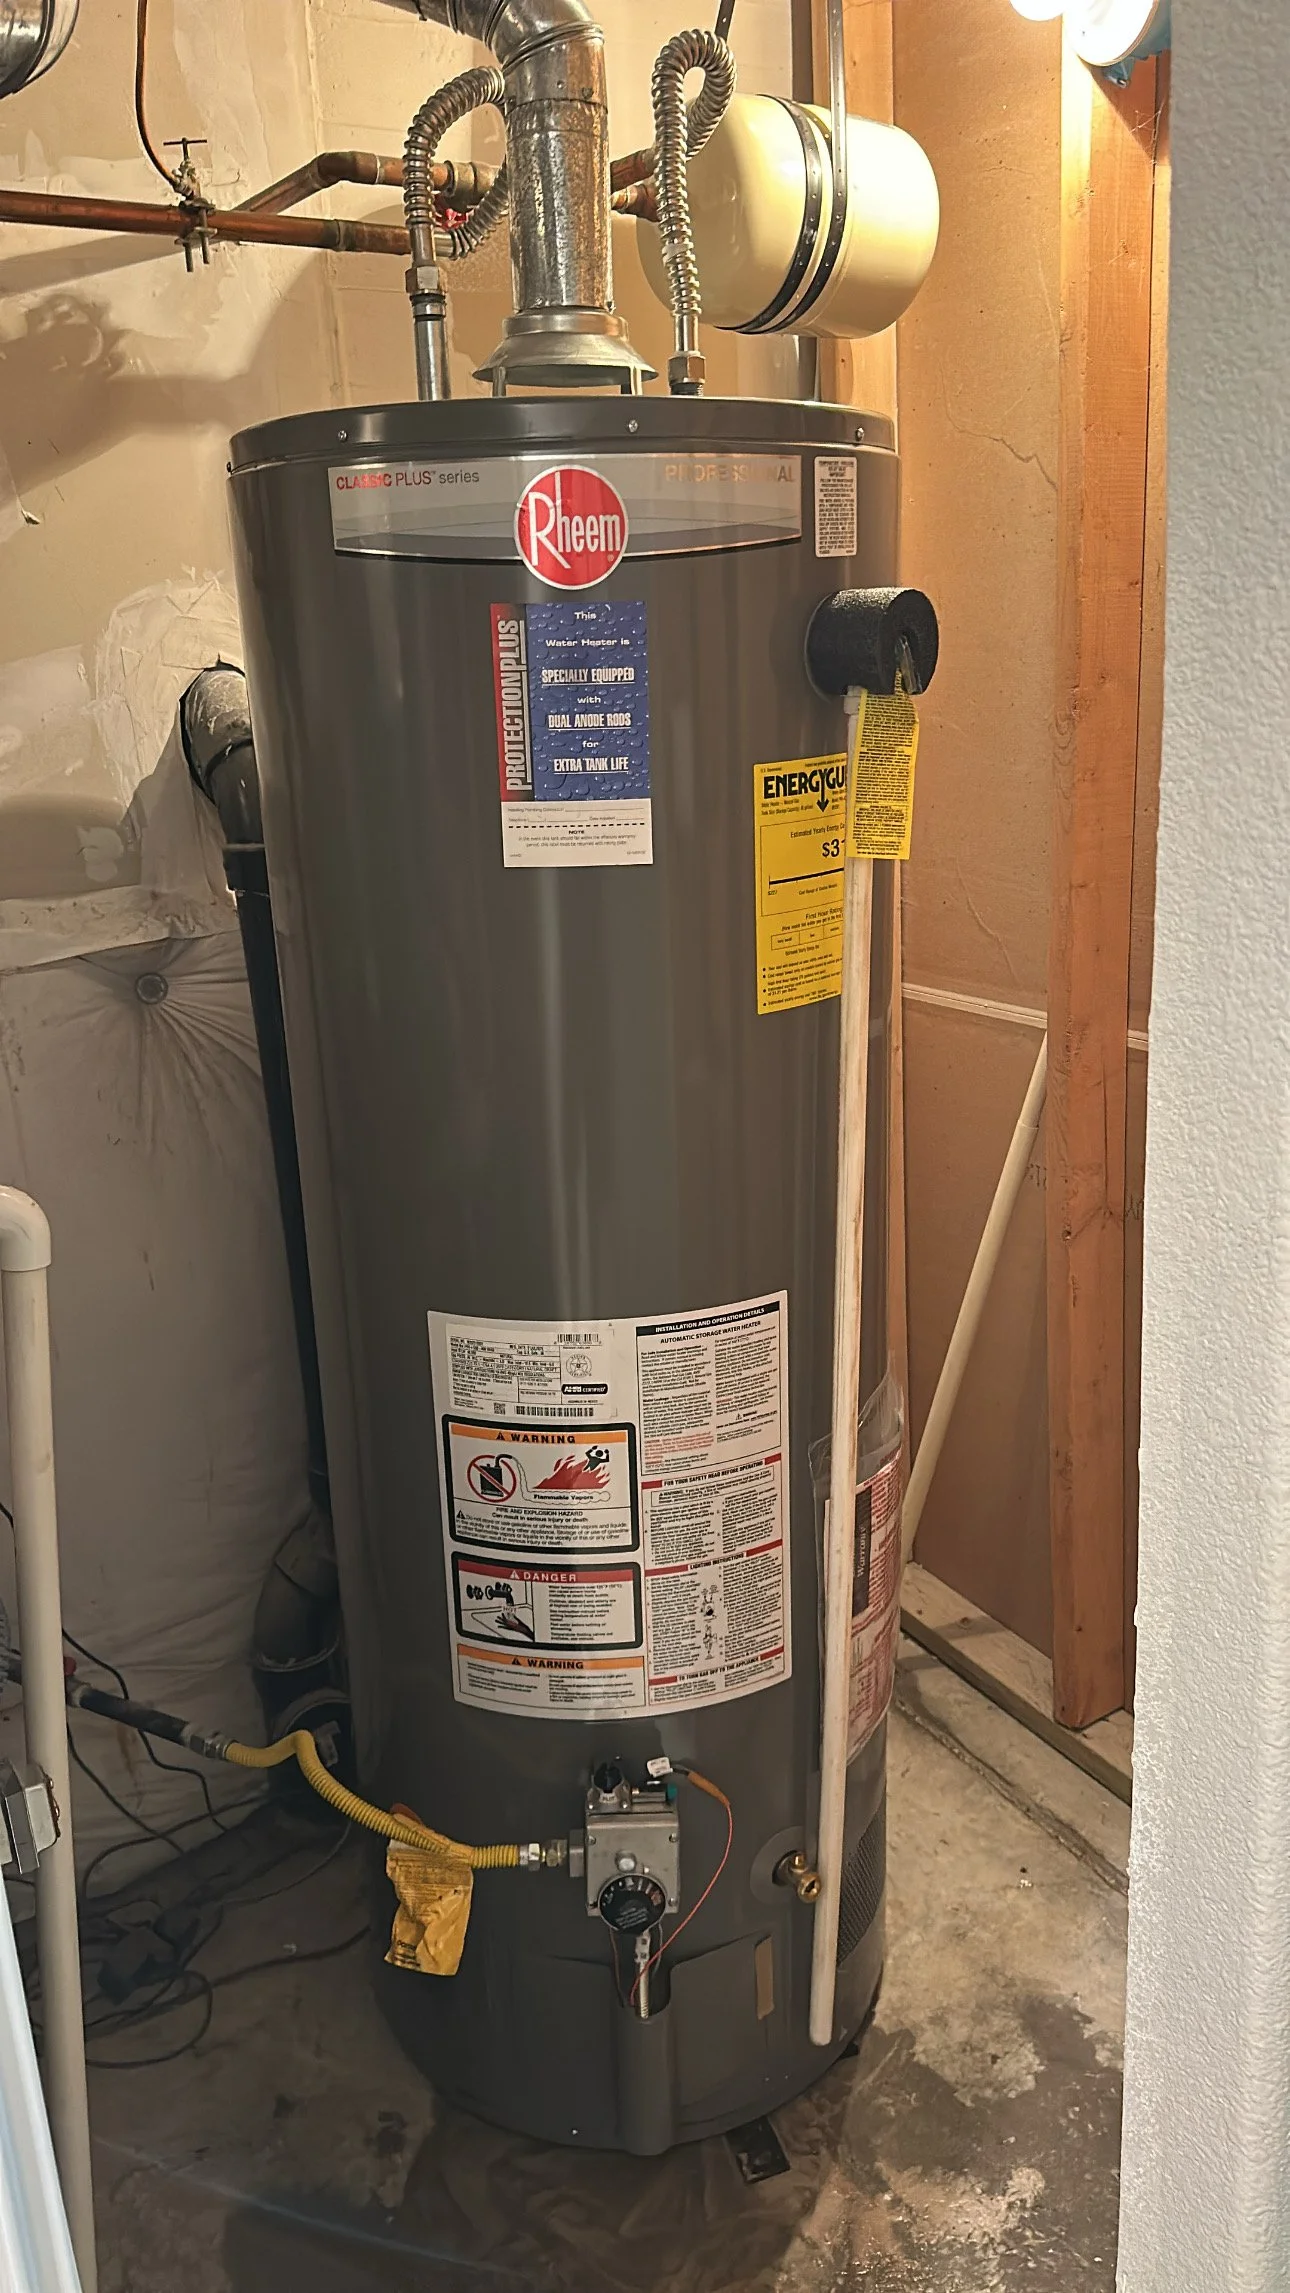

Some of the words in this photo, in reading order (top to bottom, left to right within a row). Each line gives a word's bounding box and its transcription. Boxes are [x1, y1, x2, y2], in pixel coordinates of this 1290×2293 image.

[336, 472, 392, 490] CLASSIC
[439, 470, 480, 484] series
[665, 464, 794, 482] PROFESSNAL
[528, 471, 620, 569] Rheem
[574, 611, 597, 621] This
[545, 639, 577, 647] Water
[581, 639, 617, 647] Heater
[542, 669, 588, 683] SPECIALLY
[592, 667, 634, 683] EQUIPPED
[577, 696, 601, 704] with
[548, 715, 571, 728] DUAL
[574, 714, 604, 727] ANODE
[607, 713, 631, 726] RODS
[582, 740, 599, 748] for
[554, 758, 582, 772] EXTRA
[586, 758, 608, 771] TANK
[610, 757, 629, 770] LIFE
[764, 765, 847, 800] ENERGYGU
[791, 830, 812, 838] Estimated
[827, 825, 839, 833] Energy
[655, 1323, 697, 1332] INSTALLATION
[712, 1313, 743, 1324] OPERATION
[744, 1308, 765, 1317] DETAILS
[660, 1334, 694, 1344] AUTOMATIC
[696, 1330, 721, 1339] STORAGE
[741, 1320, 761, 1330] HEATER
[511, 1433, 576, 1444] WARNING
[708, 1472, 721, 1480] READ
[721, 1467, 739, 1476] BEFORE
[739, 1461, 763, 1473] OPERATING
[858, 1526, 866, 1577] Warranty
[690, 1561, 711, 1570] LIGHTING
[712, 1552, 744, 1565] INSTRUCTIONS
[523, 1572, 577, 1582] DANGER
[527, 1658, 584, 1670] WARNING
[736, 1657, 759, 1669] APPLIANCE
